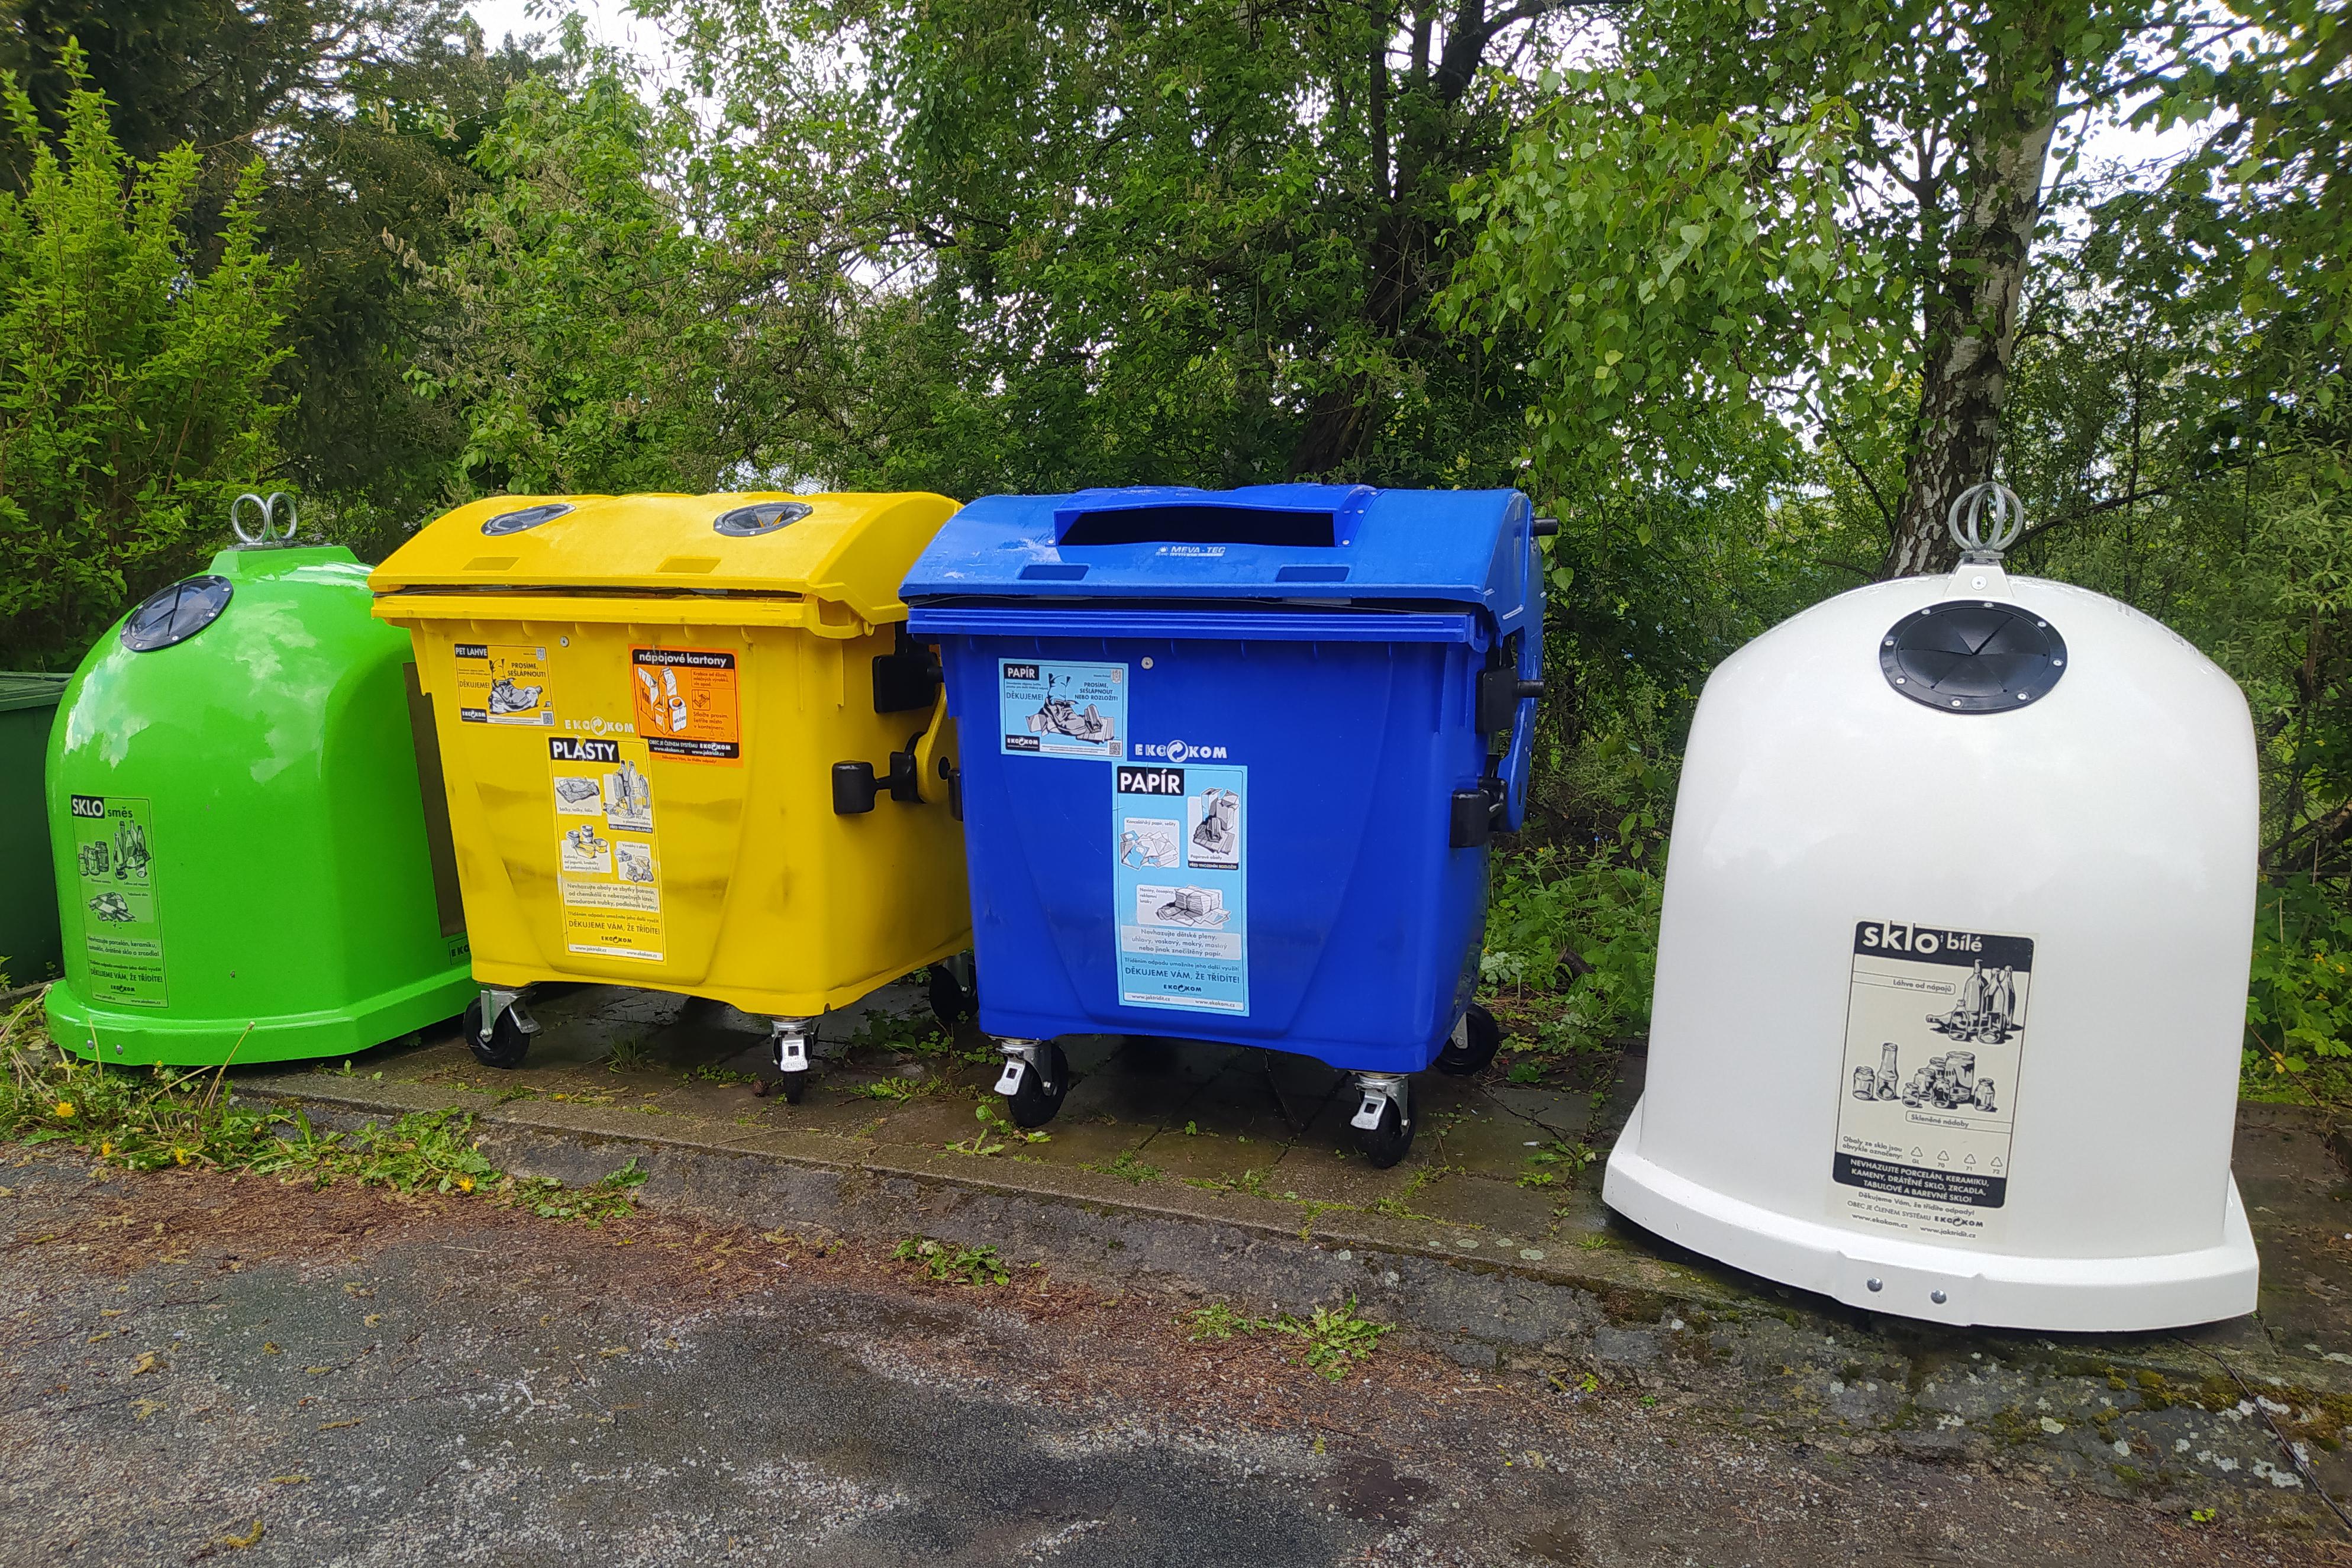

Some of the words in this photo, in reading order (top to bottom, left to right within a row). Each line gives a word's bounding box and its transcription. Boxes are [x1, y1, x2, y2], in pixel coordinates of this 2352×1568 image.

[455, 647, 466, 656] PET
[467, 647, 488, 656] LAHVE
[639, 653, 685, 665] nápojové
[686, 653, 727, 667] kartony
[511, 662, 540, 670] PROSÍME,
[1008, 666, 1035, 678] PAPÍR
[459, 679, 491, 689] DĚKUJEME!
[1006, 691, 1044, 701] DĚKUJEME!
[552, 741, 615, 761] PLASTY
[1120, 769, 1181, 793] PAPÍR
[72, 798, 104, 817] SKLO
[107, 806, 133, 818] směs
[569, 919, 605, 929] DĚKUJEME
[607, 922, 625, 931] VÁM,
[627, 923, 635, 931] ŽE
[636, 924, 660, 935] TŘÍDÍTE!
[1141, 929, 1175, 937] Nevhazujte
[1862, 919, 1939, 954] sklo
[1946, 932, 1983, 953] bílé
[138, 973, 163, 983] TŘÍDÍTE!
[1125, 966, 1169, 977] DĚKUJEME
[1170, 970, 1193, 980] VÁM,
[1195, 971, 1206, 980] ŽE
[1207, 972, 1240, 984] TŘÍDÍTE!
[1893, 979, 1914, 988] Láhve
[1927, 984, 1952, 994] nápojů
[1195, 999, 1235, 1008] www.ekokom.cz
[1911, 1114, 1942, 1125] Skleněné
[1943, 1119, 1969, 1130] nádoby
[1842, 1143, 1868, 1153] obvykle
[1869, 1148, 1903, 1160] označeny:
[1843, 1135, 1863, 1146] Obaly
[1889, 1145, 1902, 1153] jsou
[1850, 1159, 1899, 1174] NEVHAZUJTE
[1901, 1167, 1944, 1182] PORCELÁN,
[1946, 1175, 1989, 1188] KERAMIKU,
[1851, 1169, 1886, 1182] KAMENY,
[1888, 1175, 1922, 1188] DRÁTĚNÉ
[1924, 1181, 1947, 1192] SKLO,
[1948, 1185, 1987, 1196] ZRCADLA,
[1863, 1179, 1902, 1193] TABULOVÉ
[1911, 1188, 1948, 1200] BAREVNÉ
[1949, 1195, 1972, 1204] SKLO!
[1847, 1200, 1865, 1209] OBEC
[1873, 1204, 1900, 1216] ČLENEM
[1902, 1209, 1931, 1221] SYSTÉMU
[1859, 1191, 1892, 1204] Děkujeme
[1894, 1198, 1912, 1207] Vám,
[1923, 1202, 1944, 1211] třídíte
[1945, 1206, 1975, 1217] odpady!
[1852, 1213, 1908, 1228] www.ekokom.cz
[1919, 1226, 1976, 1238] www.jaktridit.cz
